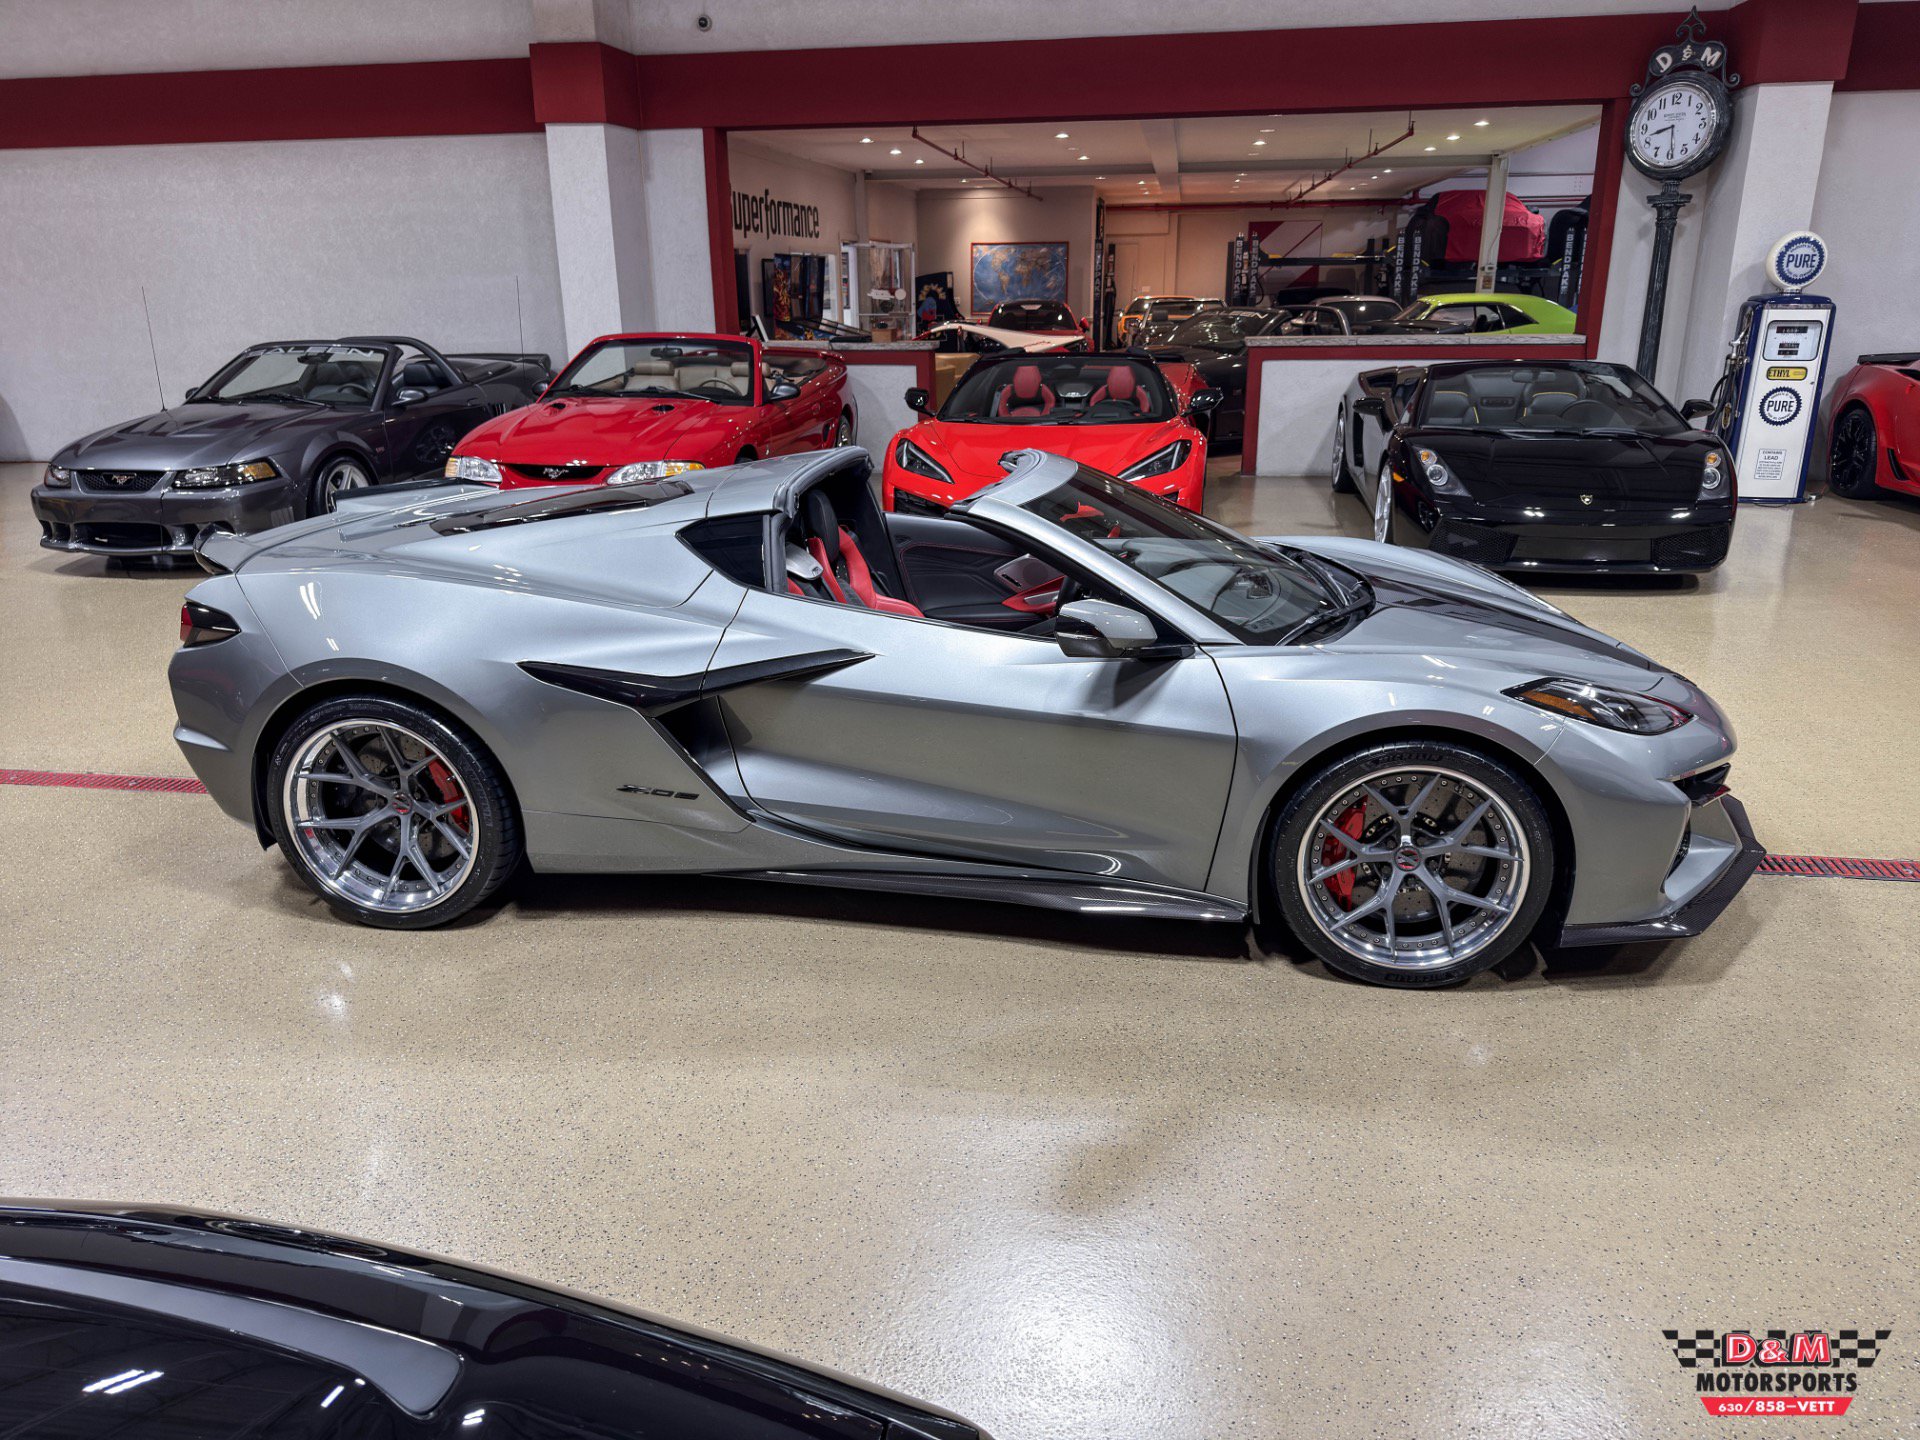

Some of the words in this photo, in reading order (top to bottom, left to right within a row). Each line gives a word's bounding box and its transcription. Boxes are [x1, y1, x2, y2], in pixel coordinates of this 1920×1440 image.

[1655, 52, 1673, 73] D
[1681, 44, 1693, 61] &
[1700, 46, 1722, 67] M
[1659, 98, 1667, 110] 11
[1671, 92, 1683, 105] 12
[1688, 95, 1692, 107] 1
[1647, 108, 1657, 121] 10
[1695, 102, 1703, 115] 2
[1640, 123, 1648, 135] 9
[1698, 118, 1707, 129] 3
[1644, 137, 1651, 149] 8
[1692, 132, 1701, 144] 4
[1654, 146, 1660, 158] 7
[1666, 149, 1674, 160] 6
[1680, 143, 1688, 155] 5
[1234, 240, 1244, 289] BENDPAK
[1250, 240, 1260, 289] BENDPAK
[1394, 237, 1405, 288] BENDPAK
[1411, 236, 1422, 288] BENDPAK
[1561, 233, 1574, 286] BENDPAK
[1786, 253, 1817, 268] PURE
[1768, 369, 1790, 378] ETHYL
[1766, 400, 1795, 412] PURE
